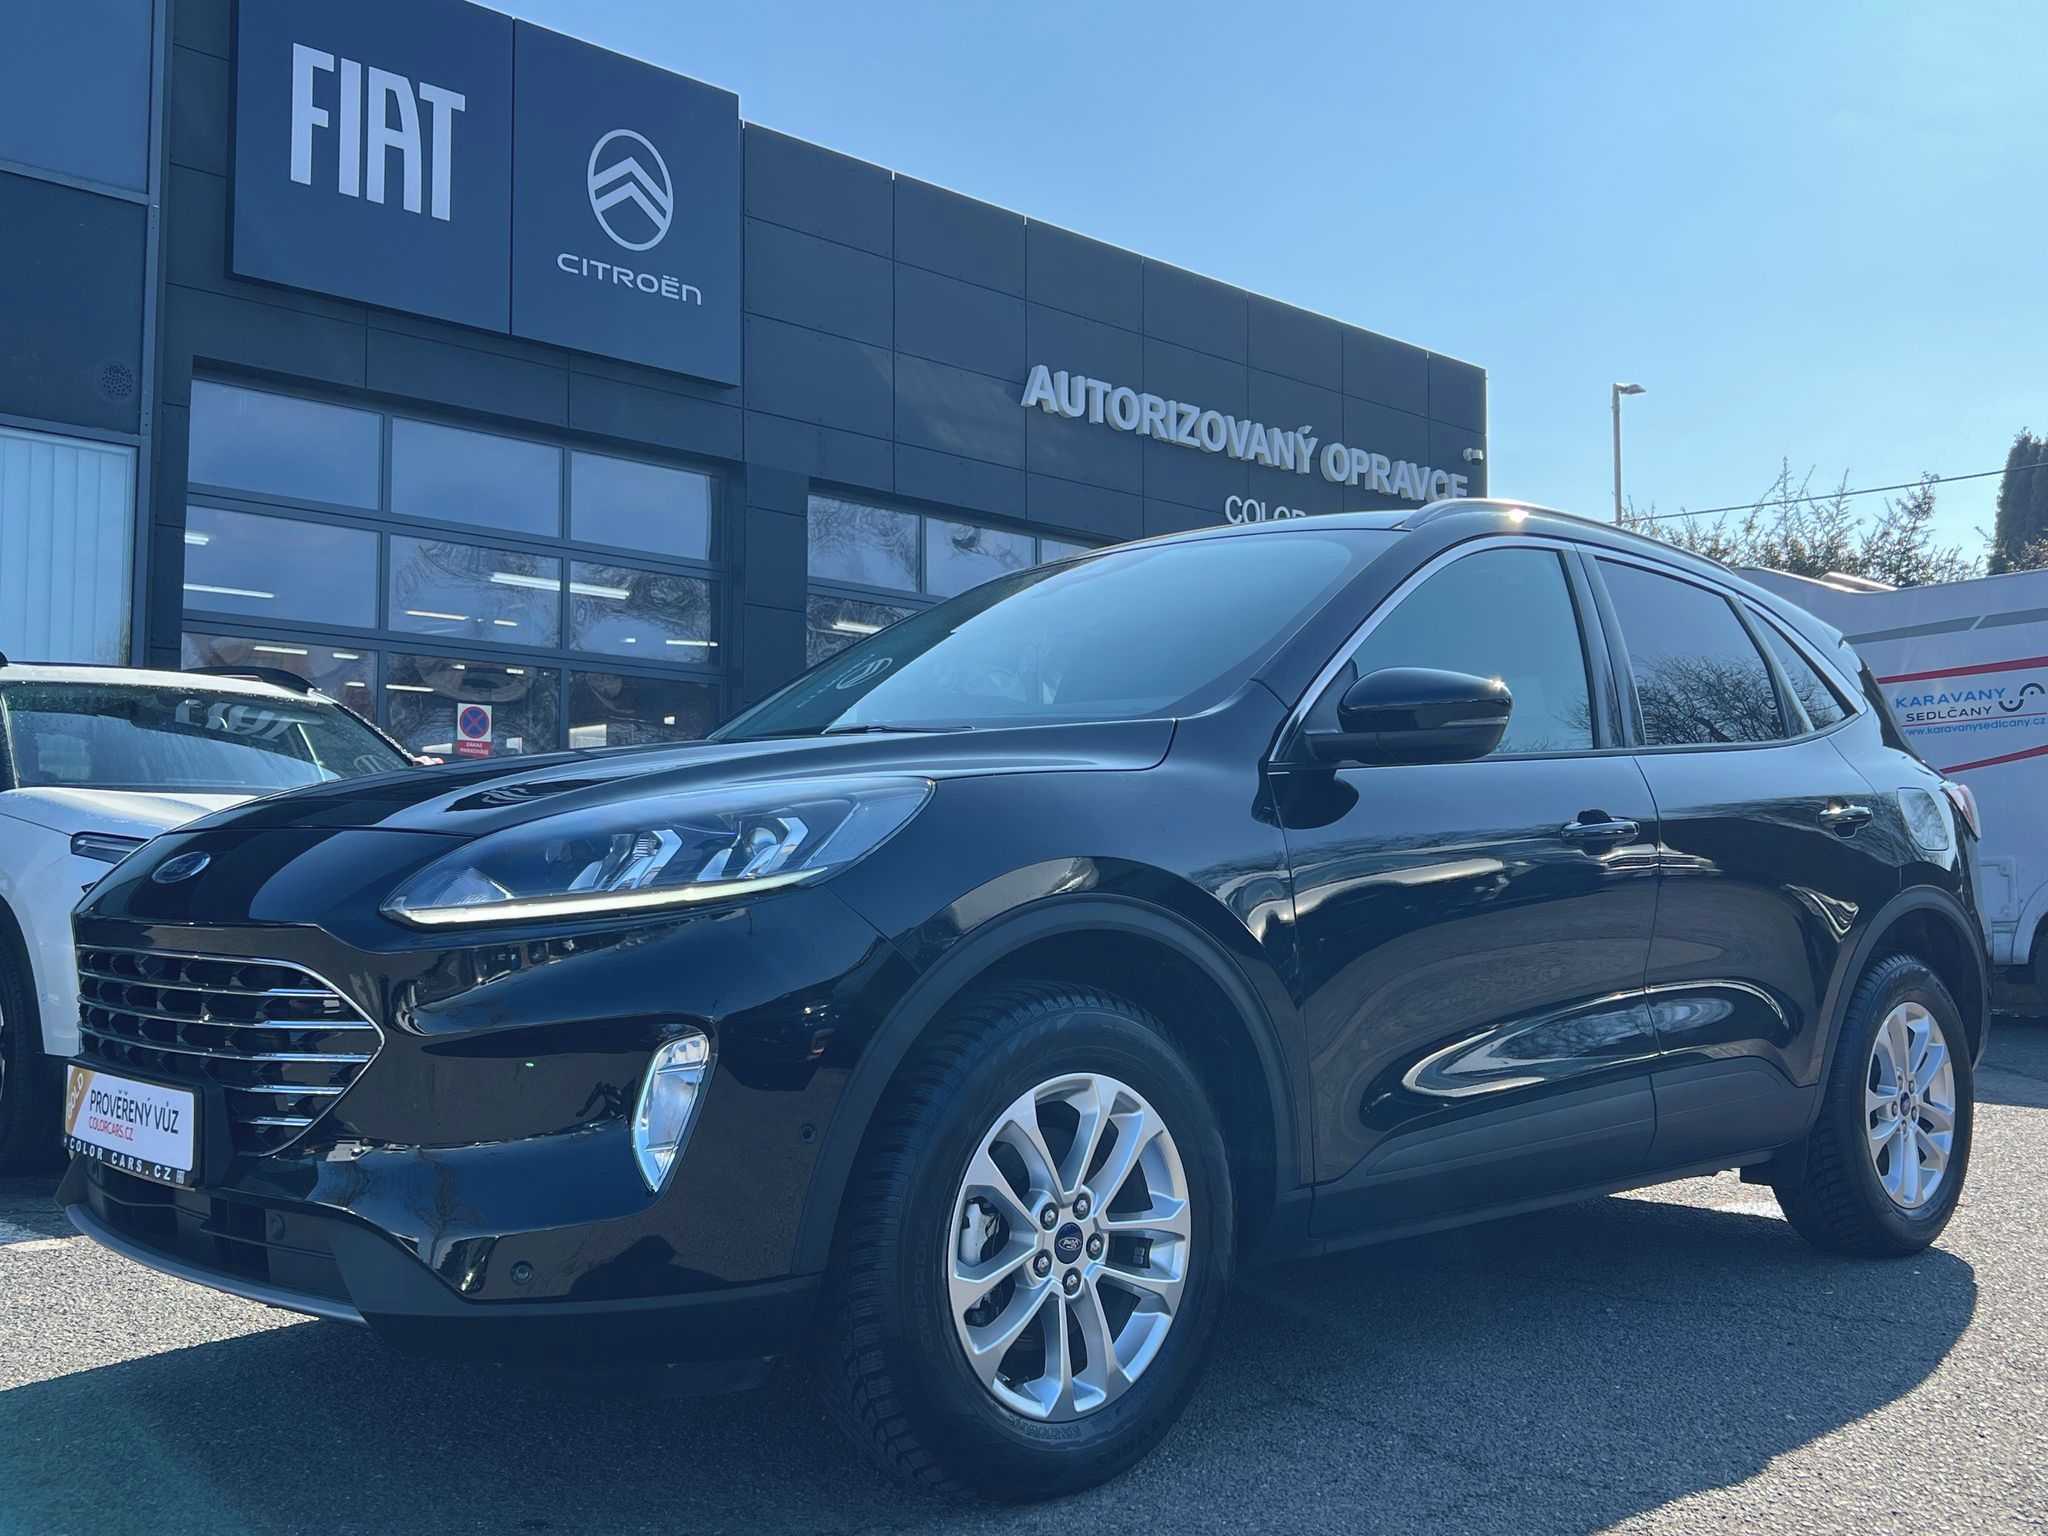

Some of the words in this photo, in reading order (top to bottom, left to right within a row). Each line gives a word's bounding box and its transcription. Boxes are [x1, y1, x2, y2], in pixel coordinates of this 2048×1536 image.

[290, 42, 466, 222] FIAT
[556, 252, 702, 306] CITROËN
[1020, 364, 1318, 474] AUTORIZOVANÝ
[1320, 442, 1468, 503] OPRAVCE
[1895, 687, 2006, 709] KARAVANY
[1905, 706, 1993, 722] SEDLČANY
[88, 1115, 134, 1142] COLORCARS.CZ
[90, 1089, 153, 1128] PROVĚŘENÝ
[154, 1101, 180, 1134] VŮZ
[69, 1137, 103, 1161] COLOR
